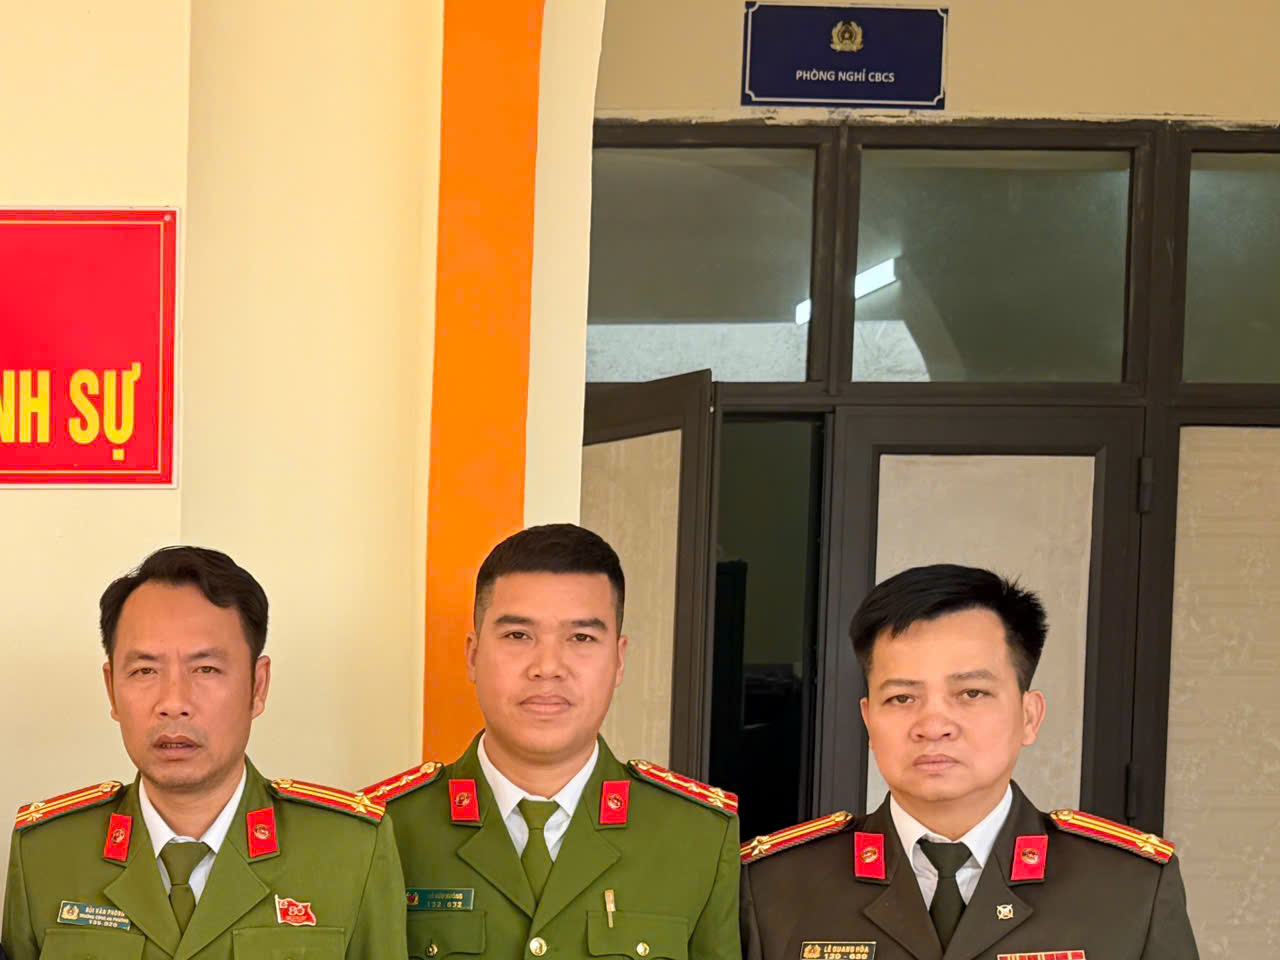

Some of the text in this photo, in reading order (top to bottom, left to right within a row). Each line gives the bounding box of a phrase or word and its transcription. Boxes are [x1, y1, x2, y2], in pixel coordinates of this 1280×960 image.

[795, 68, 895, 83] PHÒNG NGHỈ CBCS
[68, 362, 142, 461] SỰ
